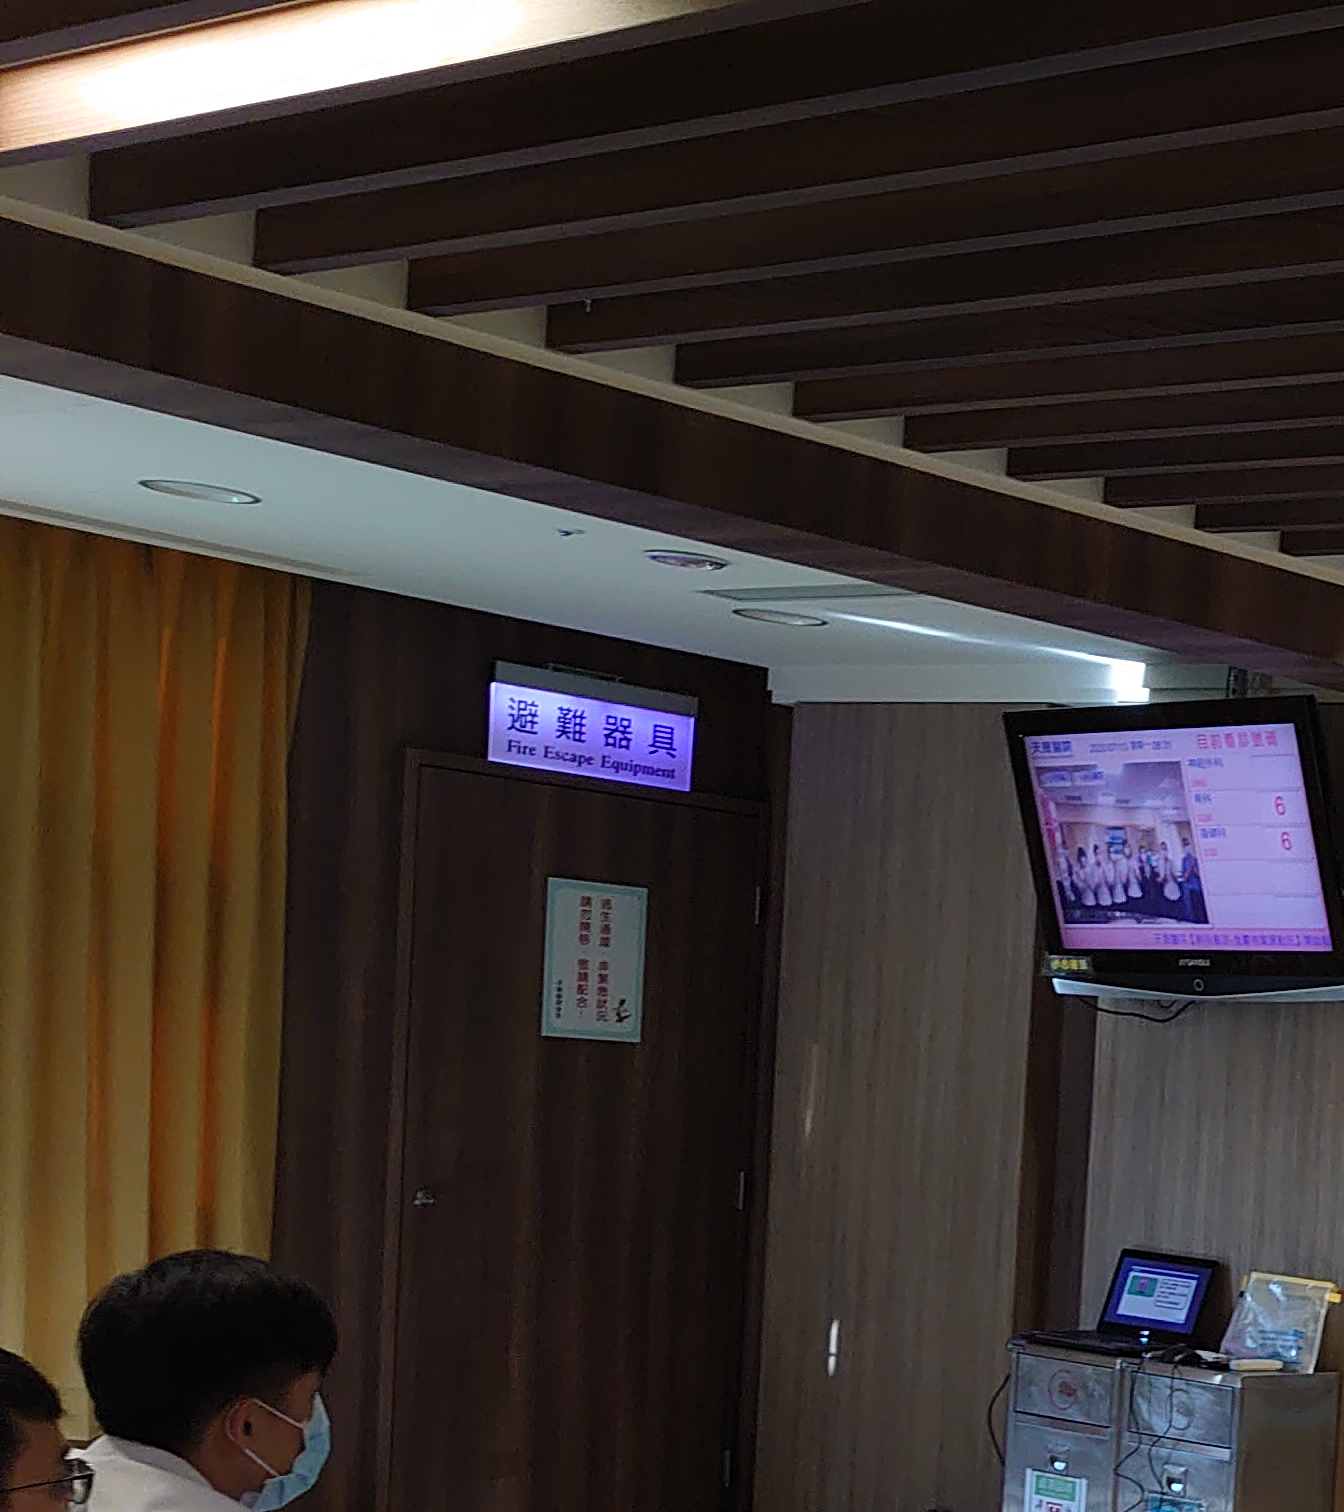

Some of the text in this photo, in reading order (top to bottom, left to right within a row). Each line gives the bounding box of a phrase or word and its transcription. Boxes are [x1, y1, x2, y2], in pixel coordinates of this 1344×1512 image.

[507, 697, 677, 759] 避難器具
[507, 739, 676, 779] Fire Escape Equipment
[1274, 795, 1287, 816] 6
[1281, 831, 1293, 851] 6
